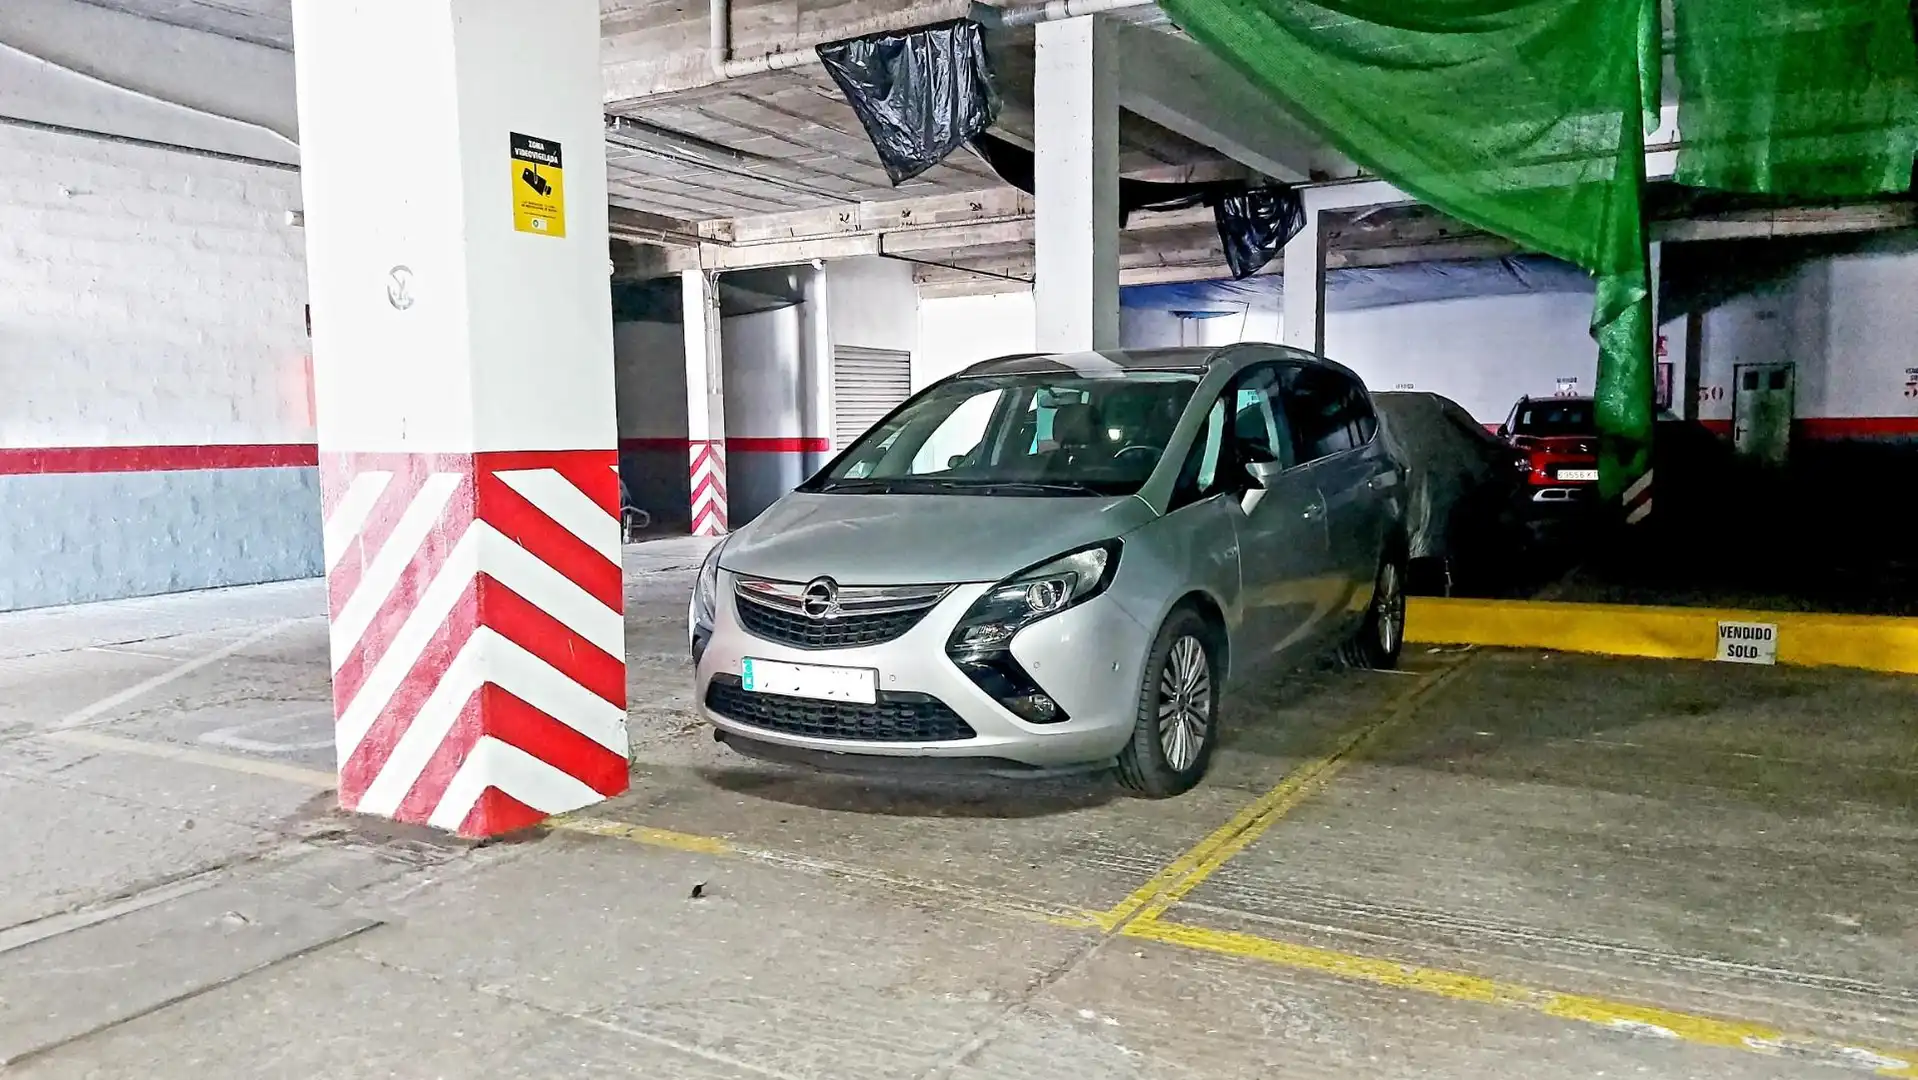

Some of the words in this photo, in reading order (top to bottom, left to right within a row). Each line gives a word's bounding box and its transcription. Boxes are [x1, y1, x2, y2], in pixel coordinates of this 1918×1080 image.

[527, 140, 545, 151] ZONA
[514, 147, 559, 164] VIDEOVIGILADA
[1720, 625, 1772, 640] VENDIDO
[1727, 644, 1758, 659] SOLD
